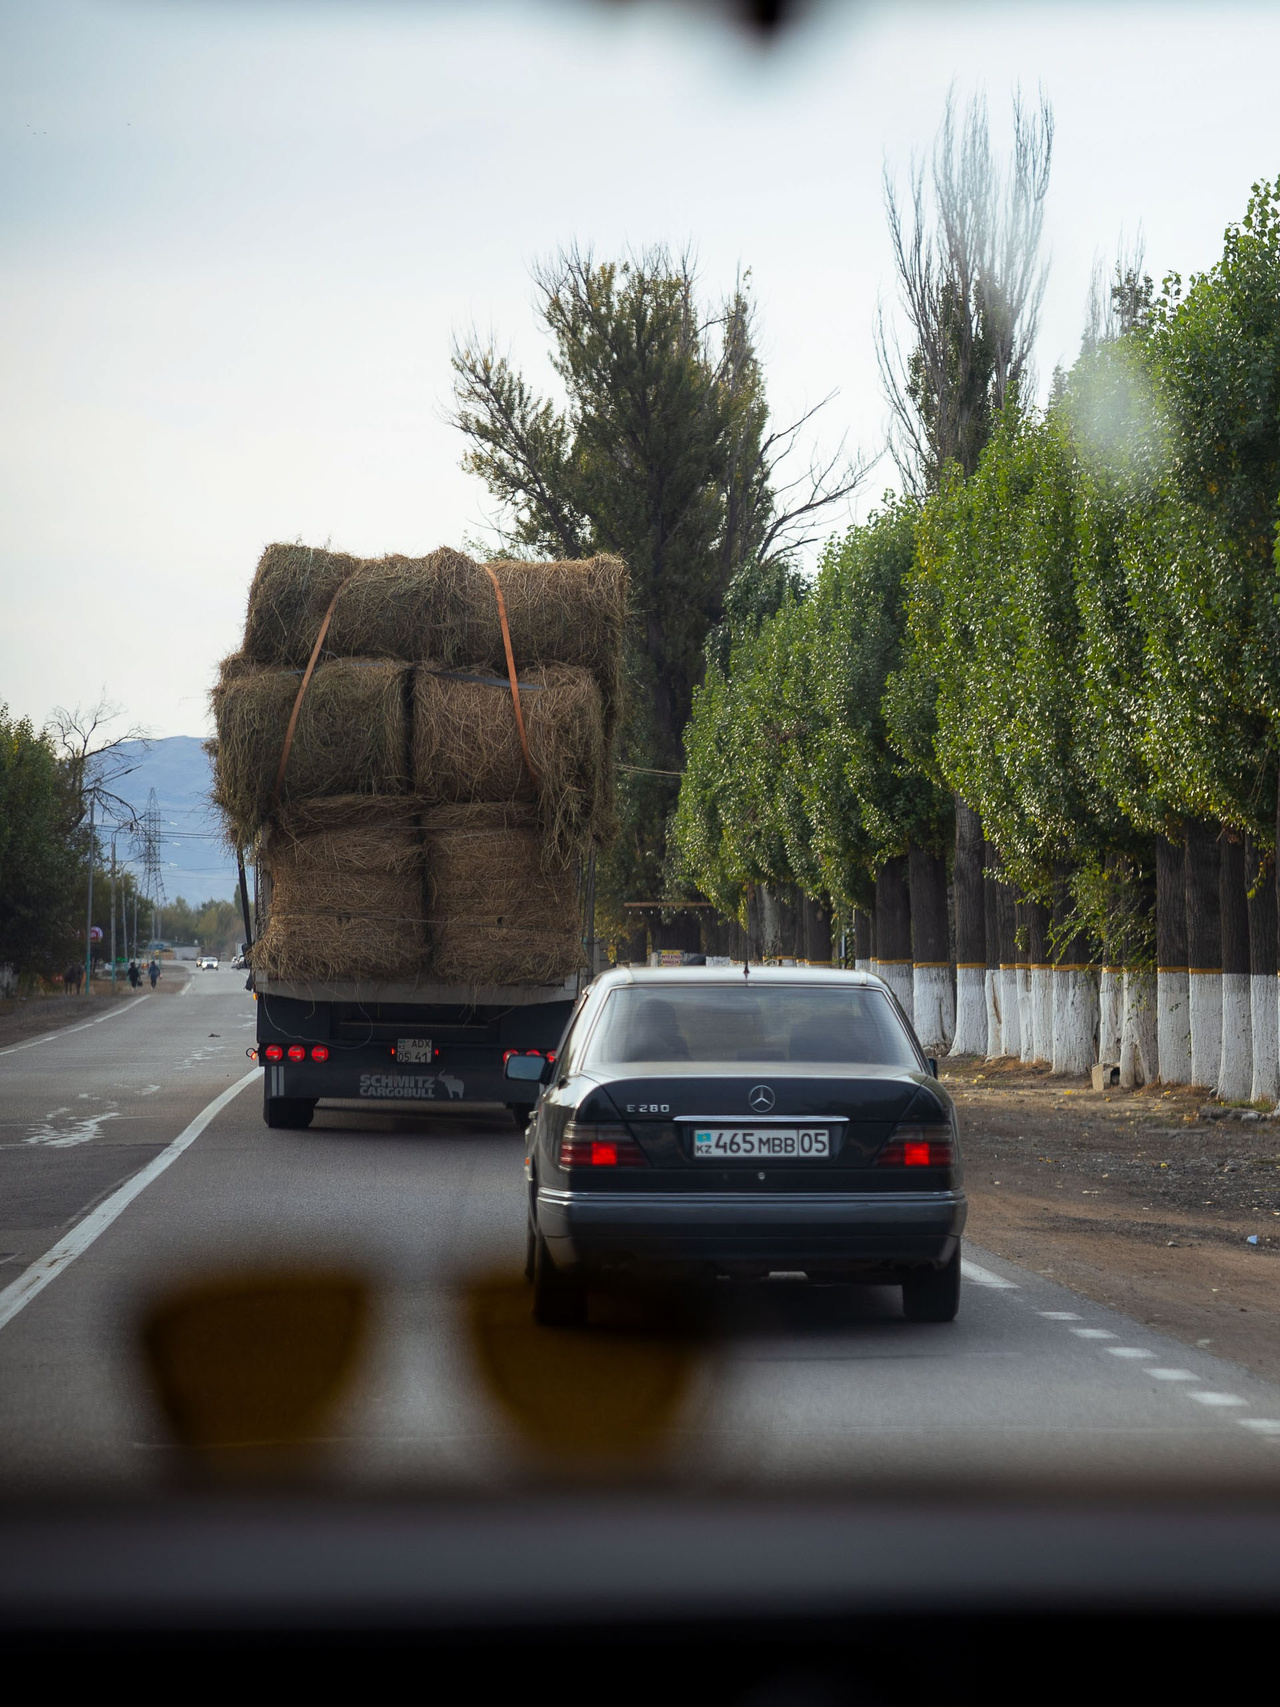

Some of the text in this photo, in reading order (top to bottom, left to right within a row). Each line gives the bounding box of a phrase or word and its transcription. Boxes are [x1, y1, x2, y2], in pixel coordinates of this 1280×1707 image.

[398, 1051, 428, 1063] 05 41
[360, 1074, 435, 1088] SCHMITZ
[360, 1087, 435, 1098] CARGOBULL
[626, 1104, 670, 1113] E 280
[696, 1132, 827, 1154] KZ 465 MBB 05
